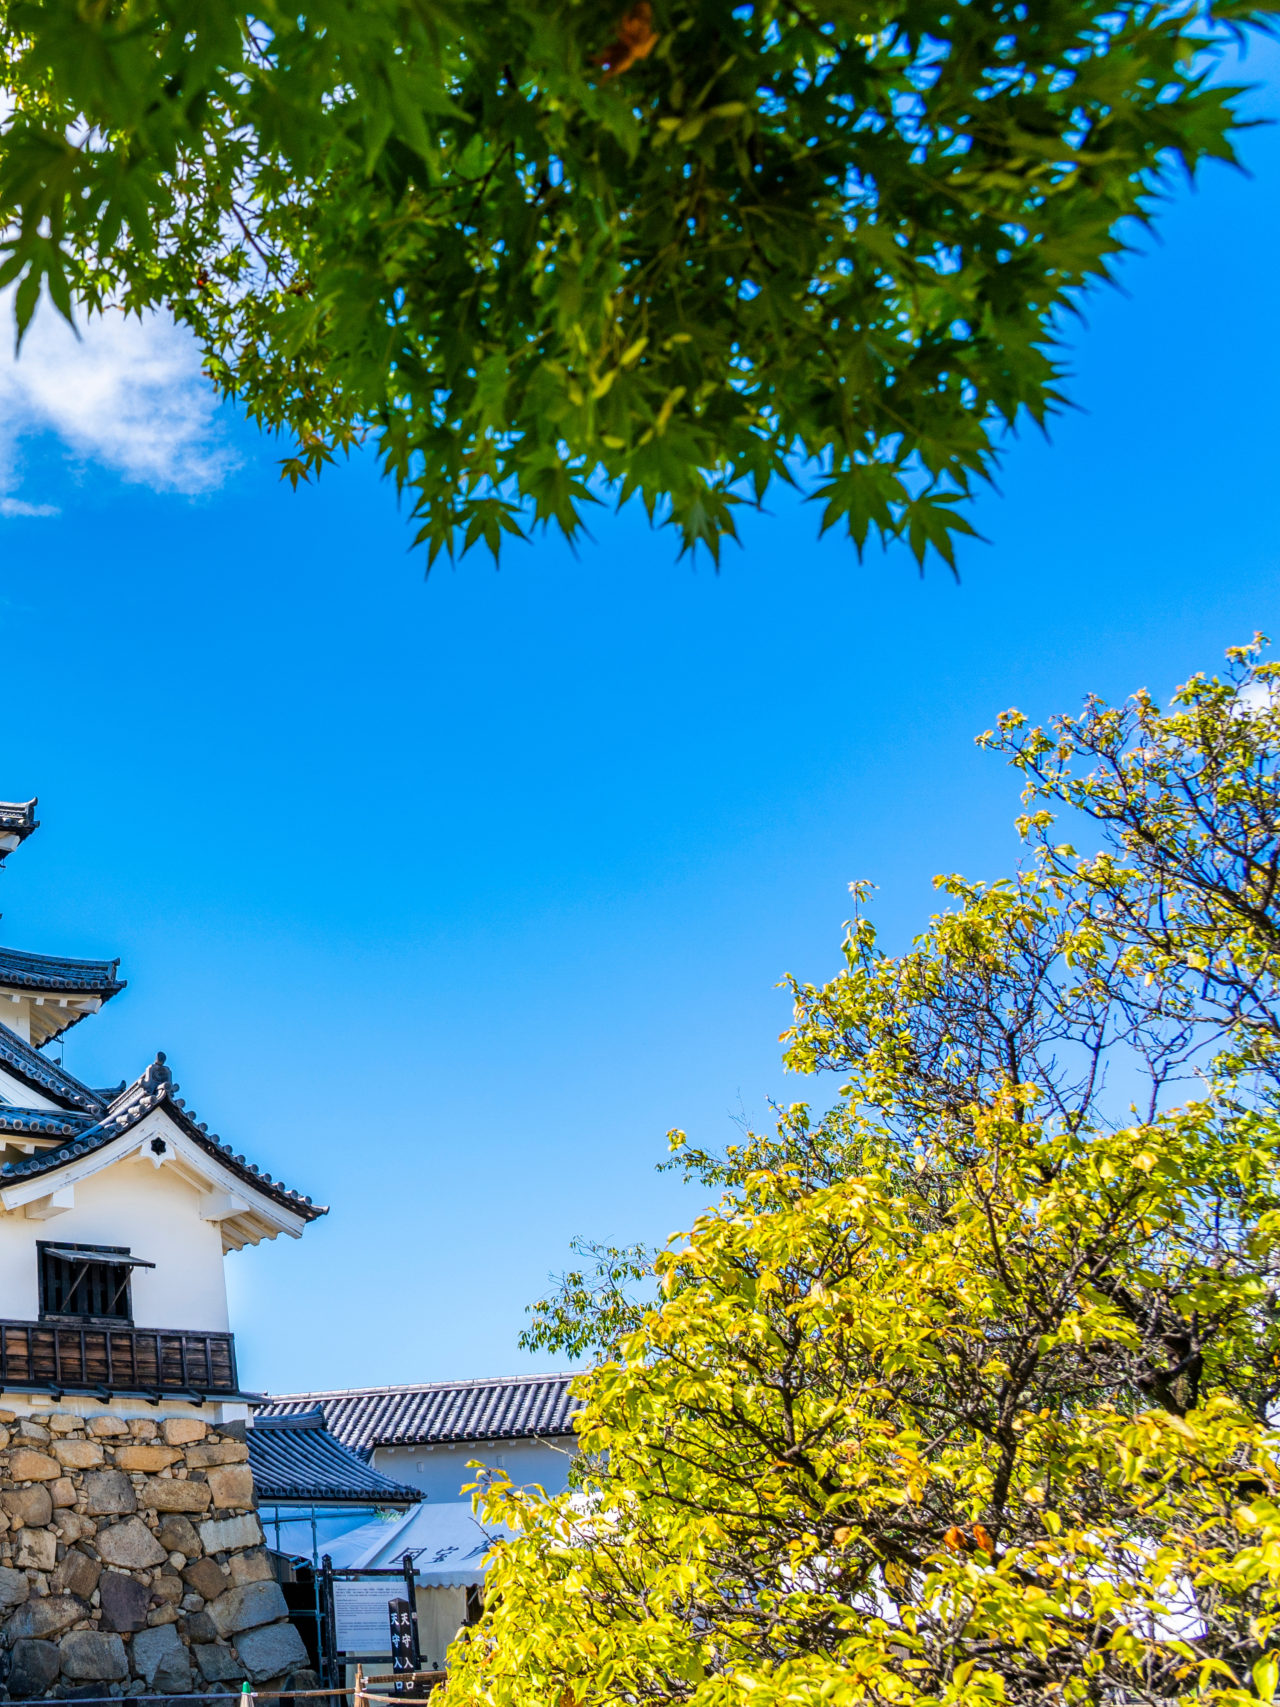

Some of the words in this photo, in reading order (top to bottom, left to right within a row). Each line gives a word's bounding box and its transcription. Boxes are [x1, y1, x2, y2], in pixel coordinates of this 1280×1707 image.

[390, 1612, 403, 1690] 天守入口
[400, 1612, 414, 1690] 天守入口
